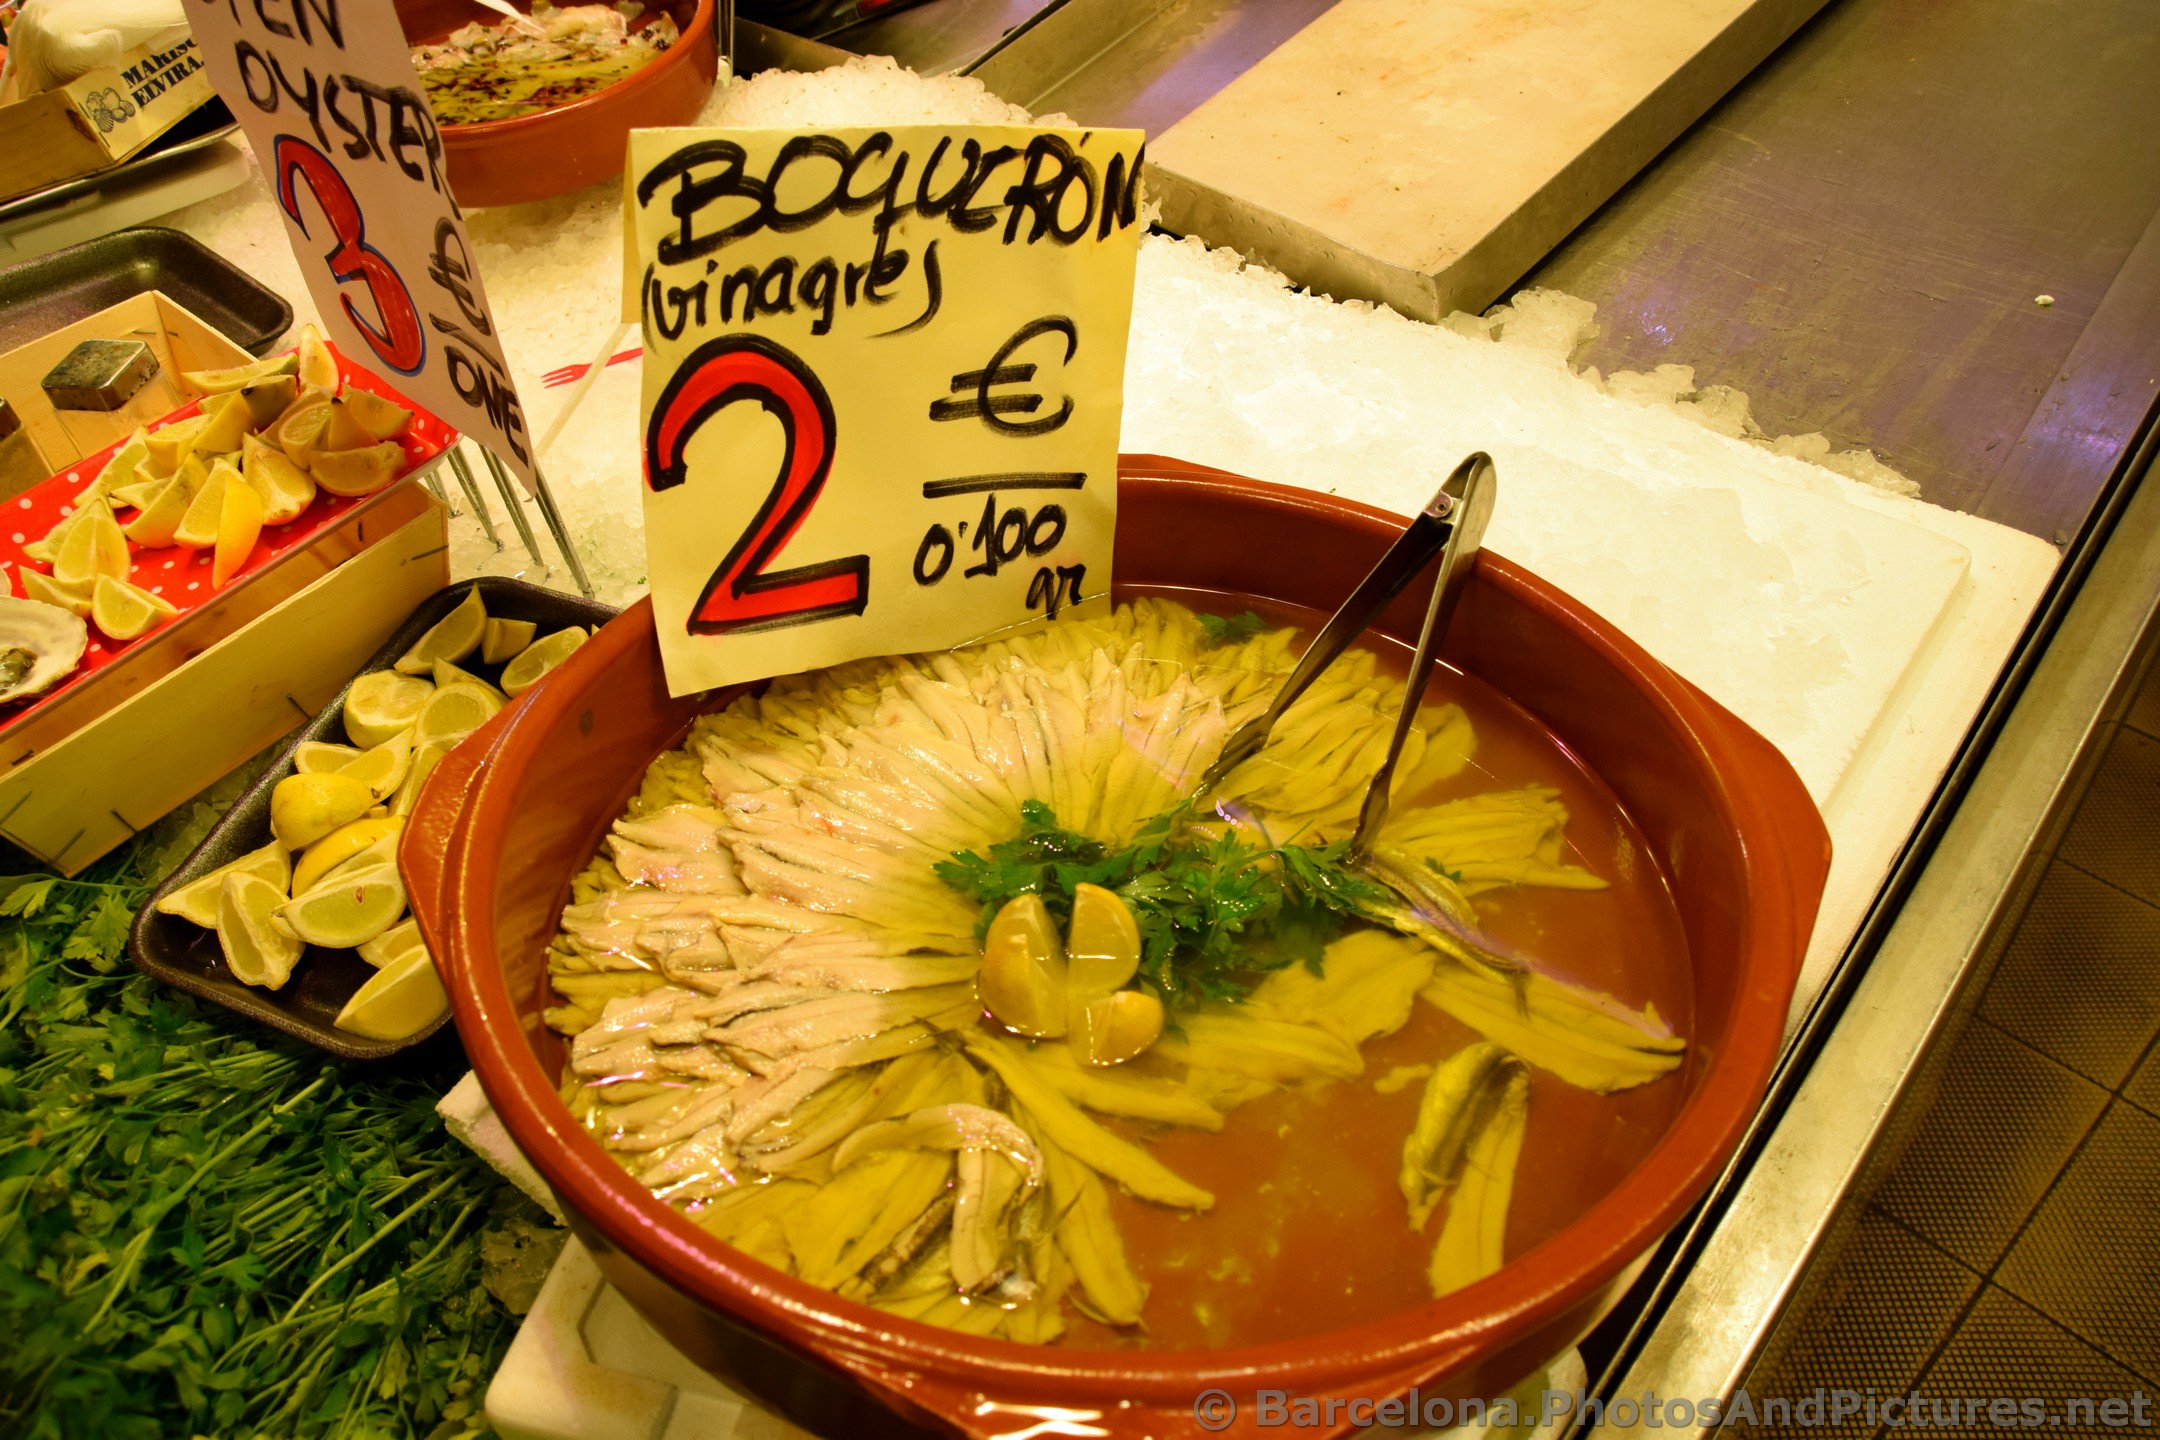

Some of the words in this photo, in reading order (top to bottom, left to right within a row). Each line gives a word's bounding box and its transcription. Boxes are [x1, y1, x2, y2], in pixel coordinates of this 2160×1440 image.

[274, 133, 425, 376] 3
[443, 345, 530, 469] ONE
[643, 333, 870, 635] 2
[929, 314, 1078, 437] €
